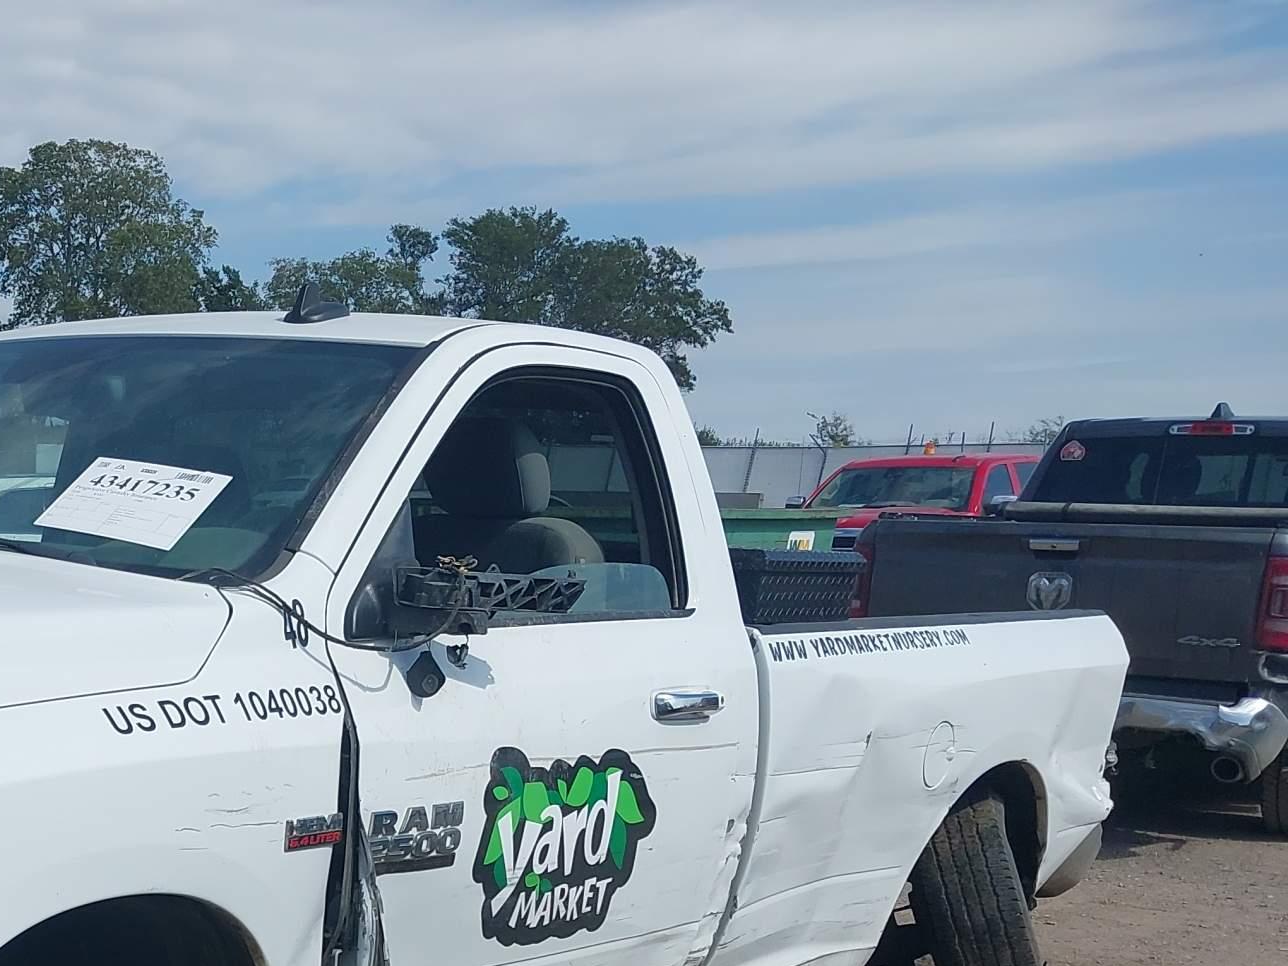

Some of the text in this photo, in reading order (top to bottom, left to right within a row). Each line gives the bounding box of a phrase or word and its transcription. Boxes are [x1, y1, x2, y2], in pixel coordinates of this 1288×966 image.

[89, 473, 201, 502] 43417235
[769, 628, 971, 662] WWW YARDMARKETNURSERY.COM
[102, 685, 341, 735] US DOT 1040038
[368, 800, 464, 837] RAM
[508, 876, 613, 929] MARKET
